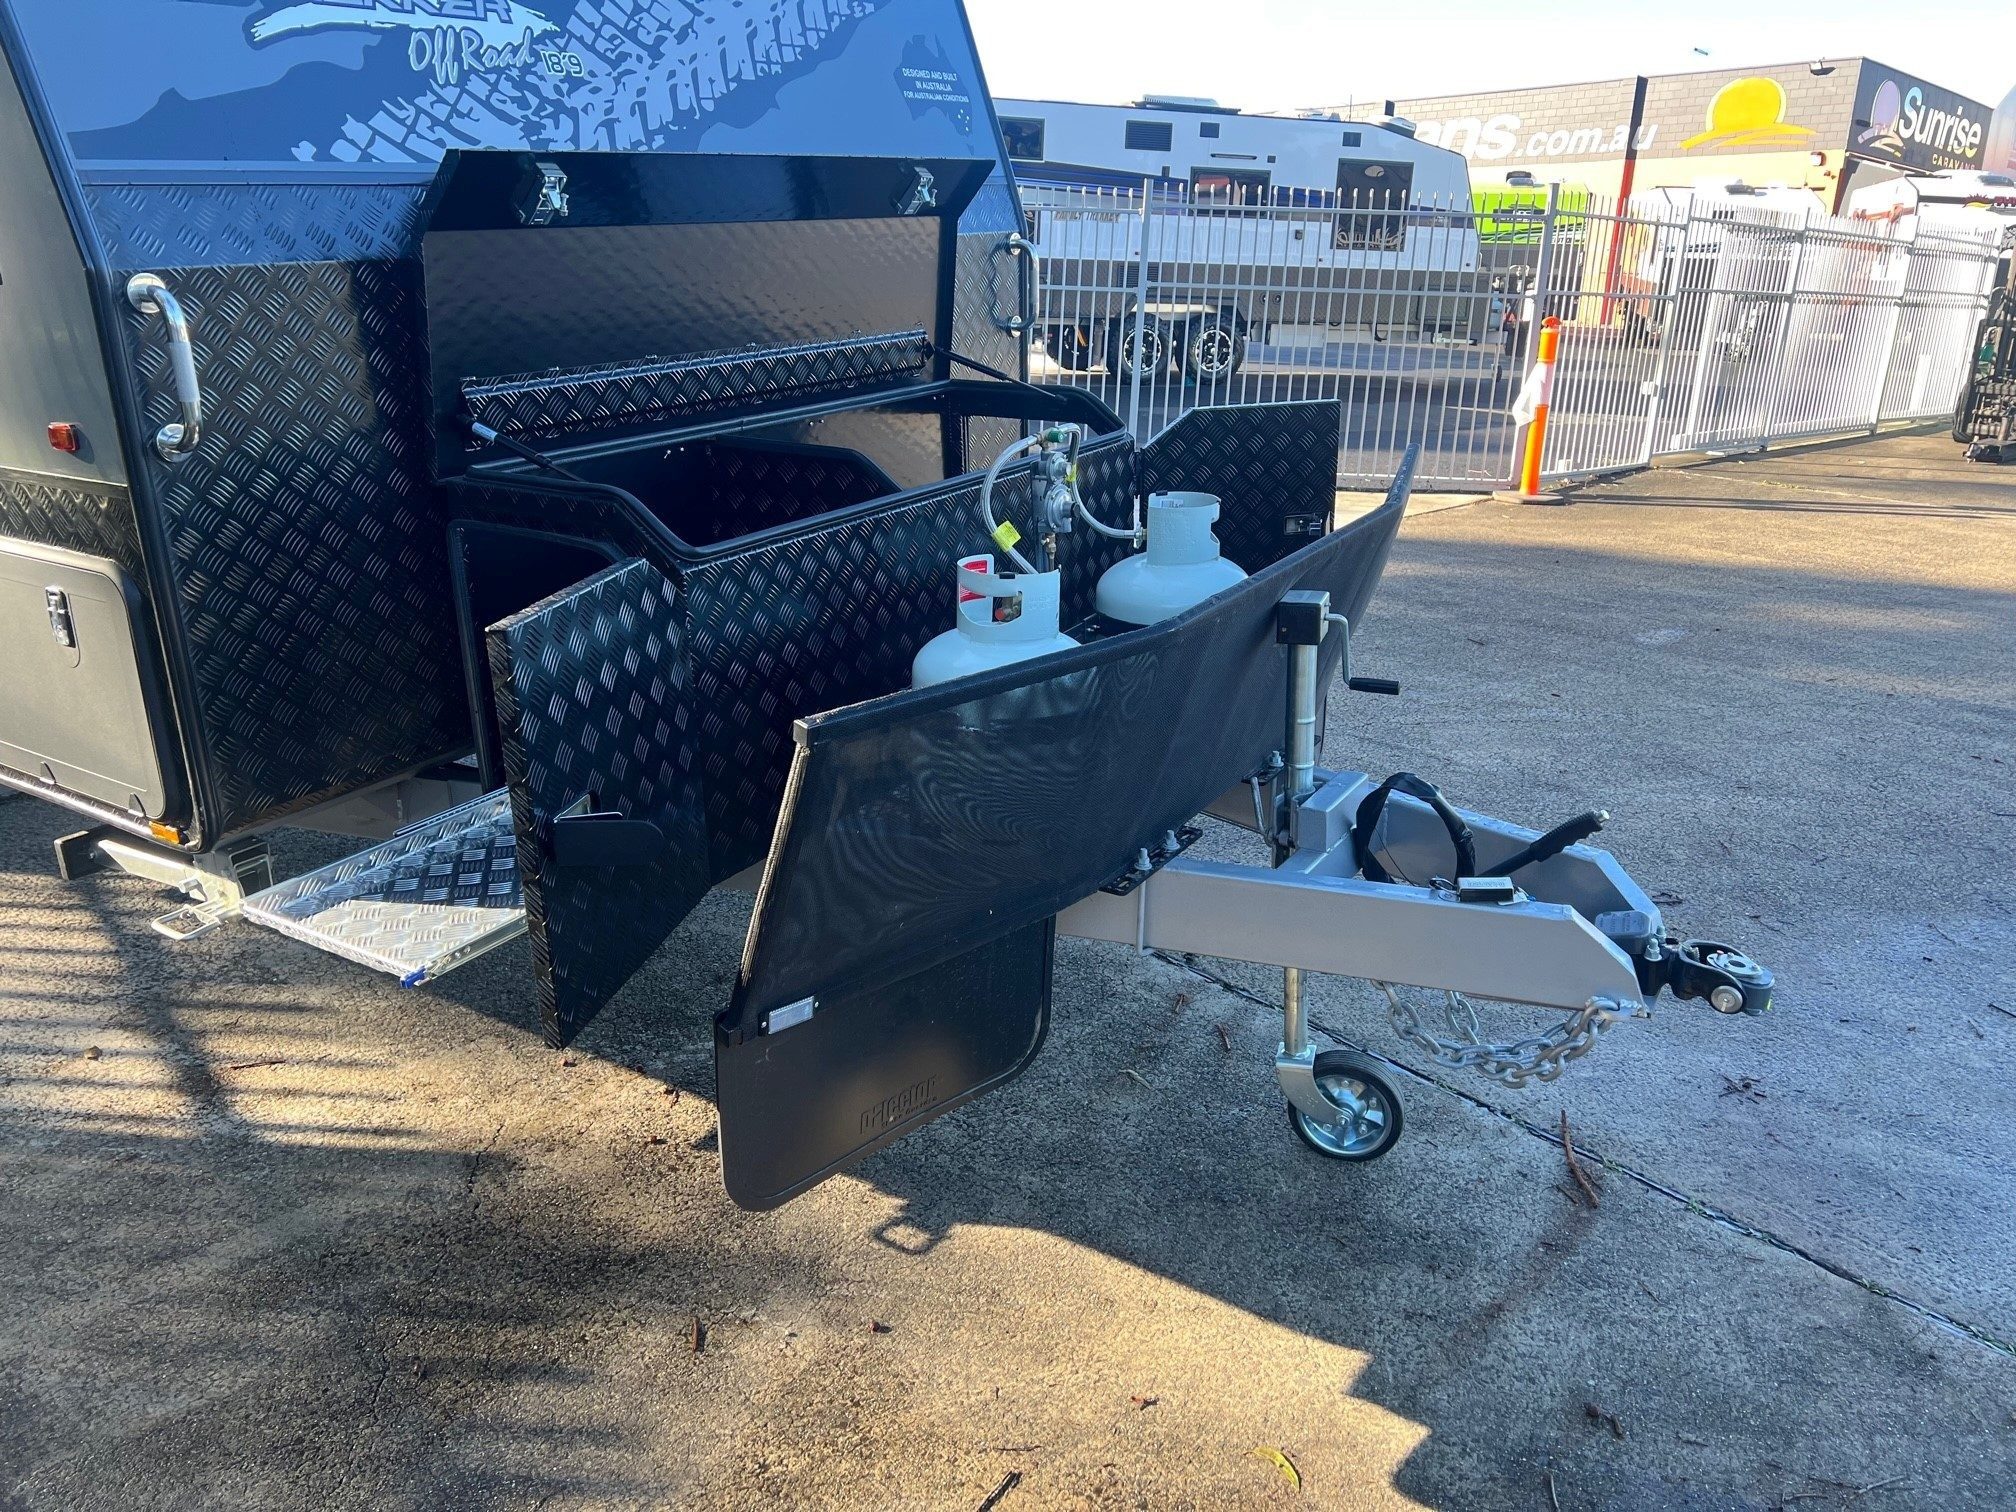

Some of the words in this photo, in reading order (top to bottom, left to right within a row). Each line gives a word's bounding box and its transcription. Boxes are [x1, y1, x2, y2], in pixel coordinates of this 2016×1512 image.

[541, 51, 584, 77] 18'9
[902, 68, 930, 78] DESIGNED
[931, 71, 942, 79] AND
[943, 73, 957, 81] BUILT
[923, 81, 952, 91] AUSTRALIA
[915, 92, 942, 100] AUSTRALIAN
[943, 94, 969, 102] CONDITIONS
[1898, 86, 1982, 159] Sunrise
[1932, 153, 1976, 171] CARAVANS
